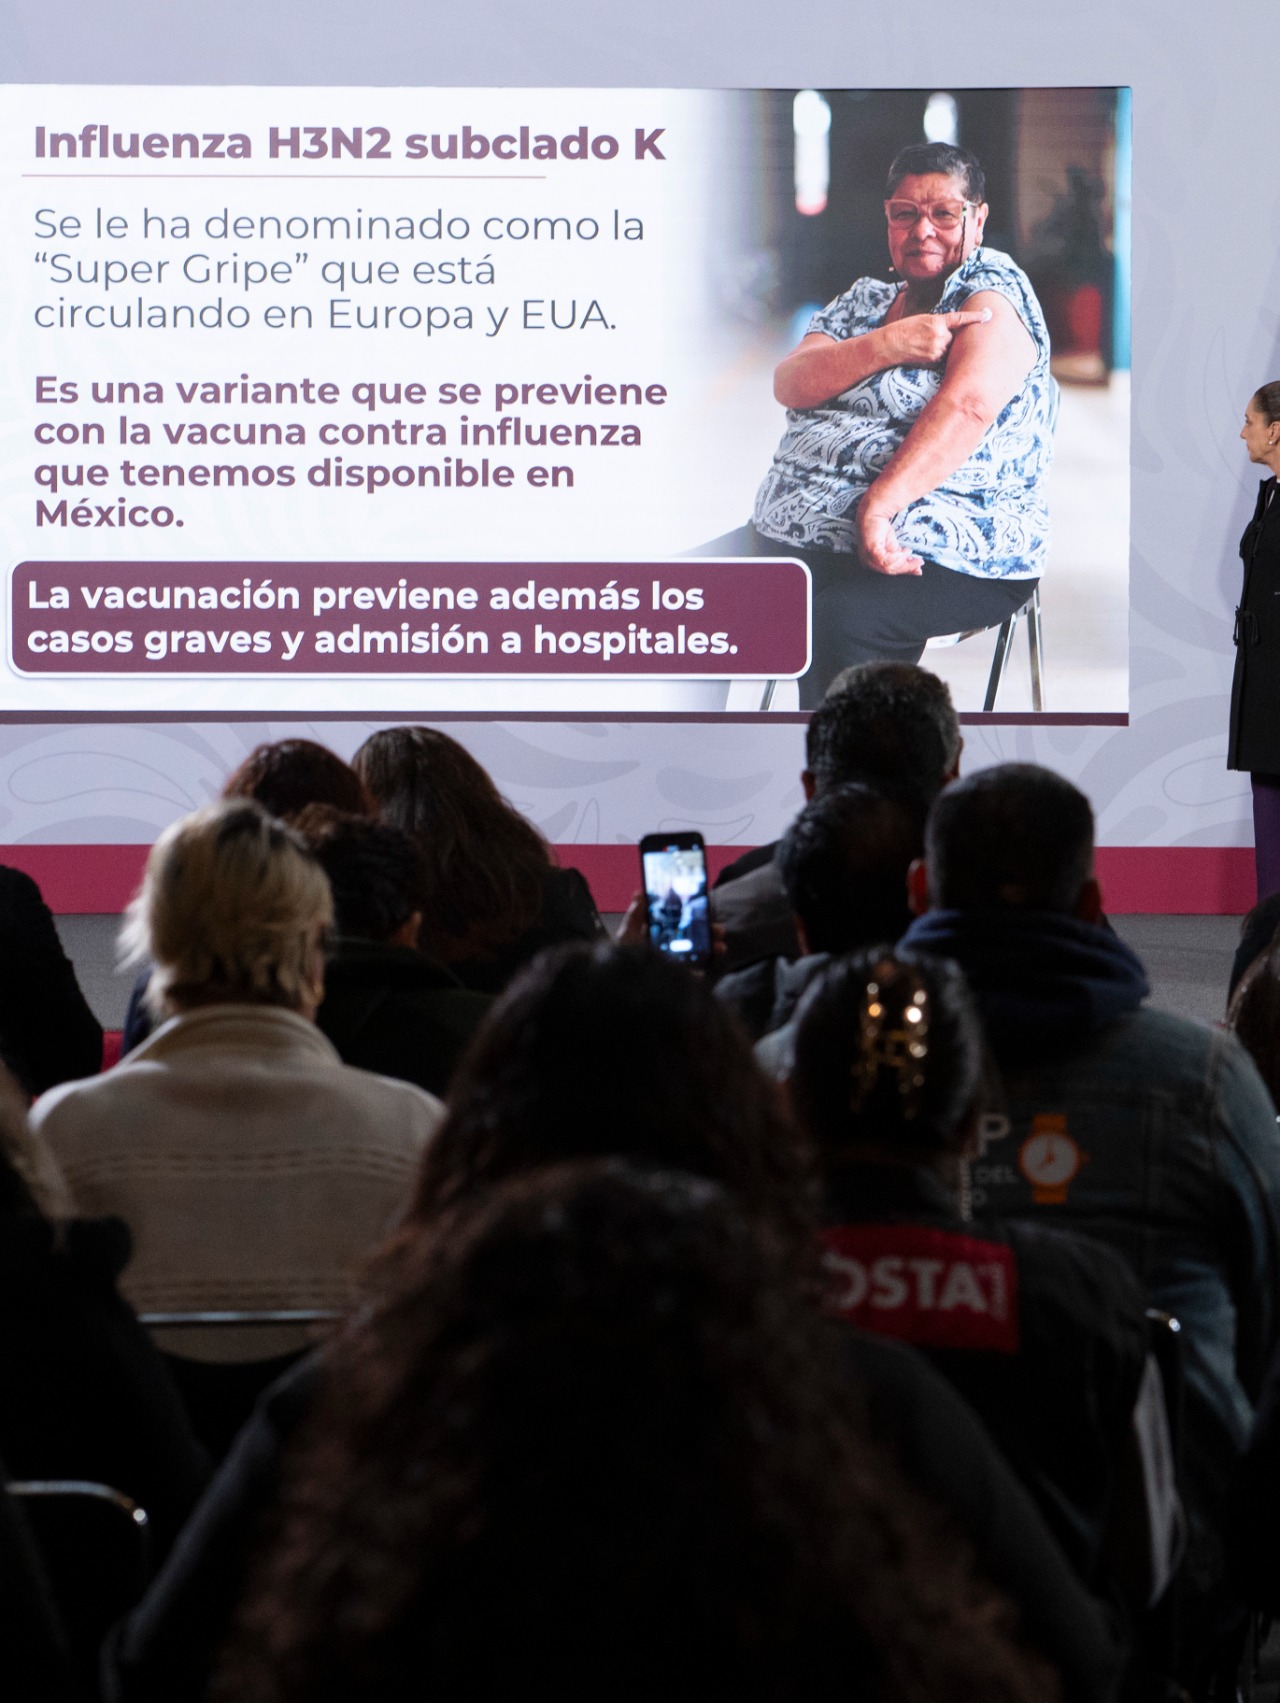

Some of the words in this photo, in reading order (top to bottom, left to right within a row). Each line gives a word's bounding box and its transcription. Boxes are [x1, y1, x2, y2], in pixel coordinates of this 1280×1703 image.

[35, 123, 252, 159] Influenza
[269, 126, 392, 160] H3N2
[405, 125, 620, 161] subclado
[634, 128, 667, 161] K
[34, 208, 82, 239] Se
[96, 207, 129, 239] le
[143, 207, 190, 239] ha
[204, 207, 471, 240] denominado
[483, 217, 600, 241] como
[614, 208, 644, 241] la
[34, 251, 170, 293] “Super
[182, 252, 309, 293] Gripe”
[321, 261, 400, 293] que
[413, 253, 495, 285] está
[34, 296, 251, 329] circulando
[263, 305, 313, 329] en
[330, 298, 473, 337] Europa
[485, 306, 509, 338] y
[523, 299, 617, 330] EUA.
[35, 375, 79, 404] Es
[91, 381, 164, 404] una
[175, 372, 340, 405] variante
[351, 382, 427, 412] que
[438, 382, 482, 405] se
[495, 374, 668, 412] previene
[34, 422, 105, 445] con
[119, 415, 151, 445] la
[162, 423, 306, 446] vacuna
[318, 419, 447, 446] contra
[460, 414, 642, 447] influenza
[34, 464, 110, 494] que
[119, 460, 296, 487] tenemos
[307, 455, 515, 495] disponible
[526, 465, 574, 488] en
[35, 496, 185, 528] México.
[28, 580, 70, 609] La
[80, 577, 300, 610] vacunación
[313, 578, 479, 617] previene
[489, 579, 641, 611] además
[652, 580, 705, 611] los
[27, 629, 134, 654] casos
[144, 630, 272, 661] graves
[280, 630, 305, 661] y
[314, 622, 489, 654] admisión
[500, 631, 522, 654] a
[534, 622, 738, 661] hospitales.
